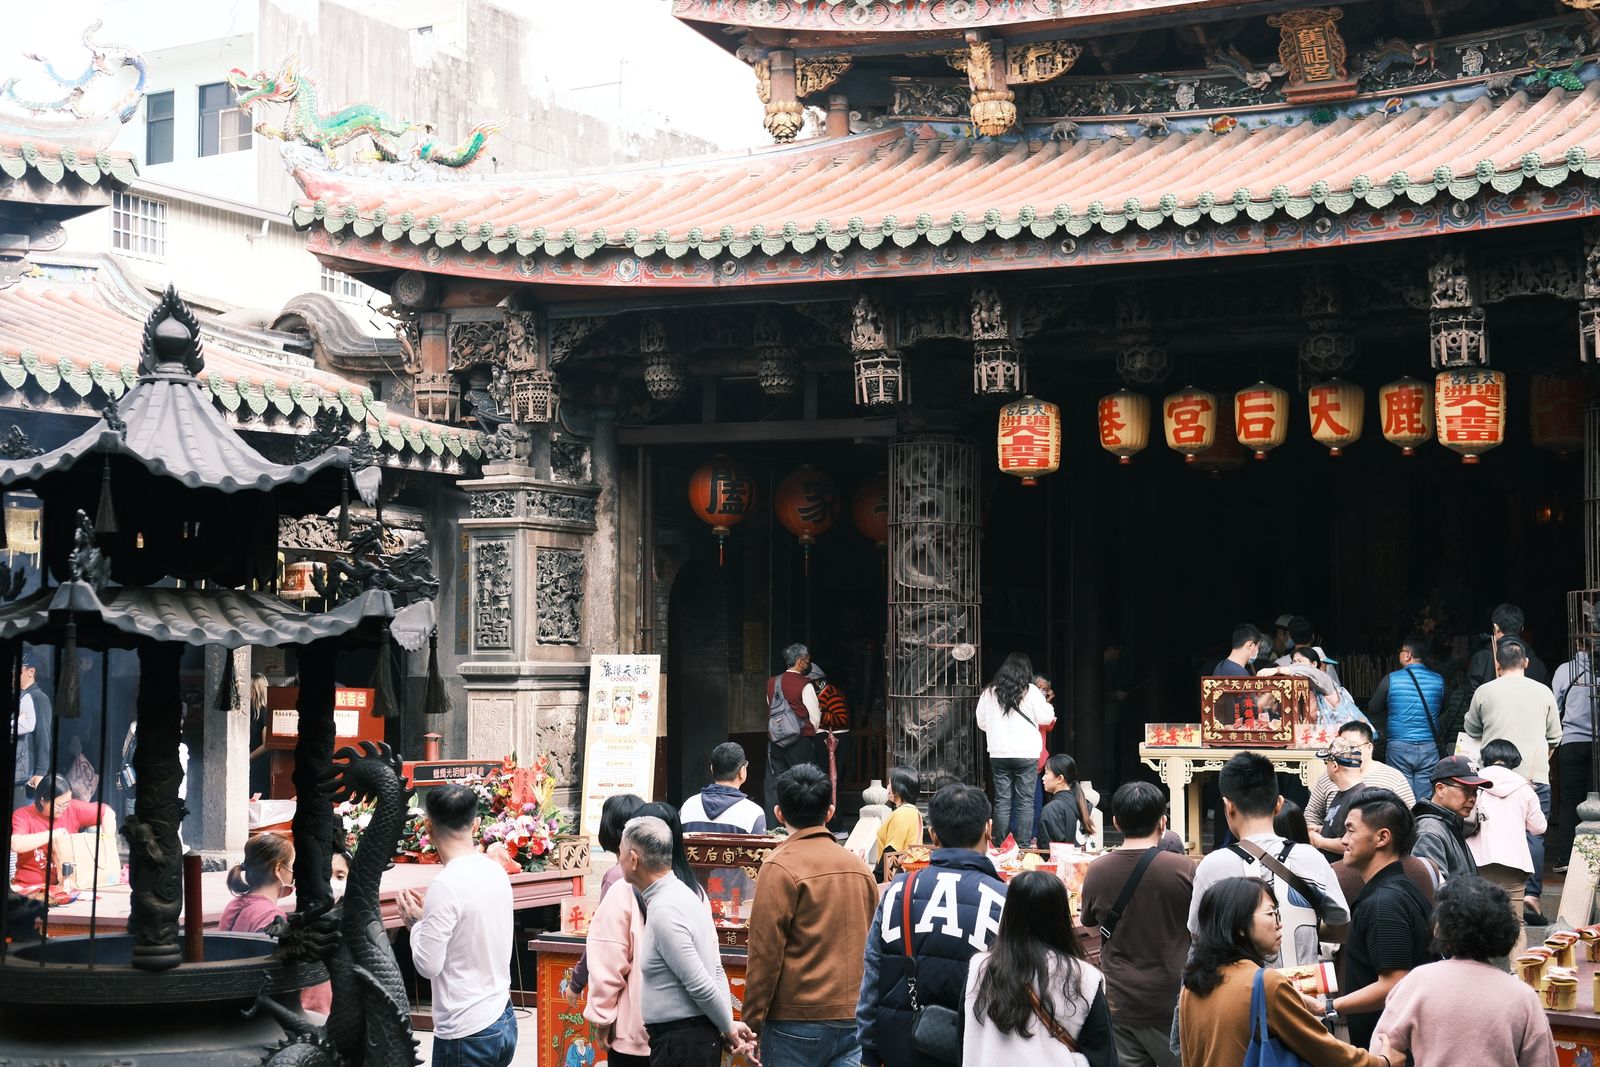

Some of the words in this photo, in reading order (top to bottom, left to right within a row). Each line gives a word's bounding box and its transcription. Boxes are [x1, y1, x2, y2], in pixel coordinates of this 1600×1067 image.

[1006, 402, 1047, 416] 天后宮
[1167, 394, 1212, 444] 宮
[1237, 390, 1276, 440] 后
[1310, 386, 1351, 436] 天
[1383, 385, 1427, 435] 鹿
[1230, 680, 1264, 691] 天后宮
[1301, 729, 1341, 745] 平安
[687, 847, 735, 864] 天后宮
